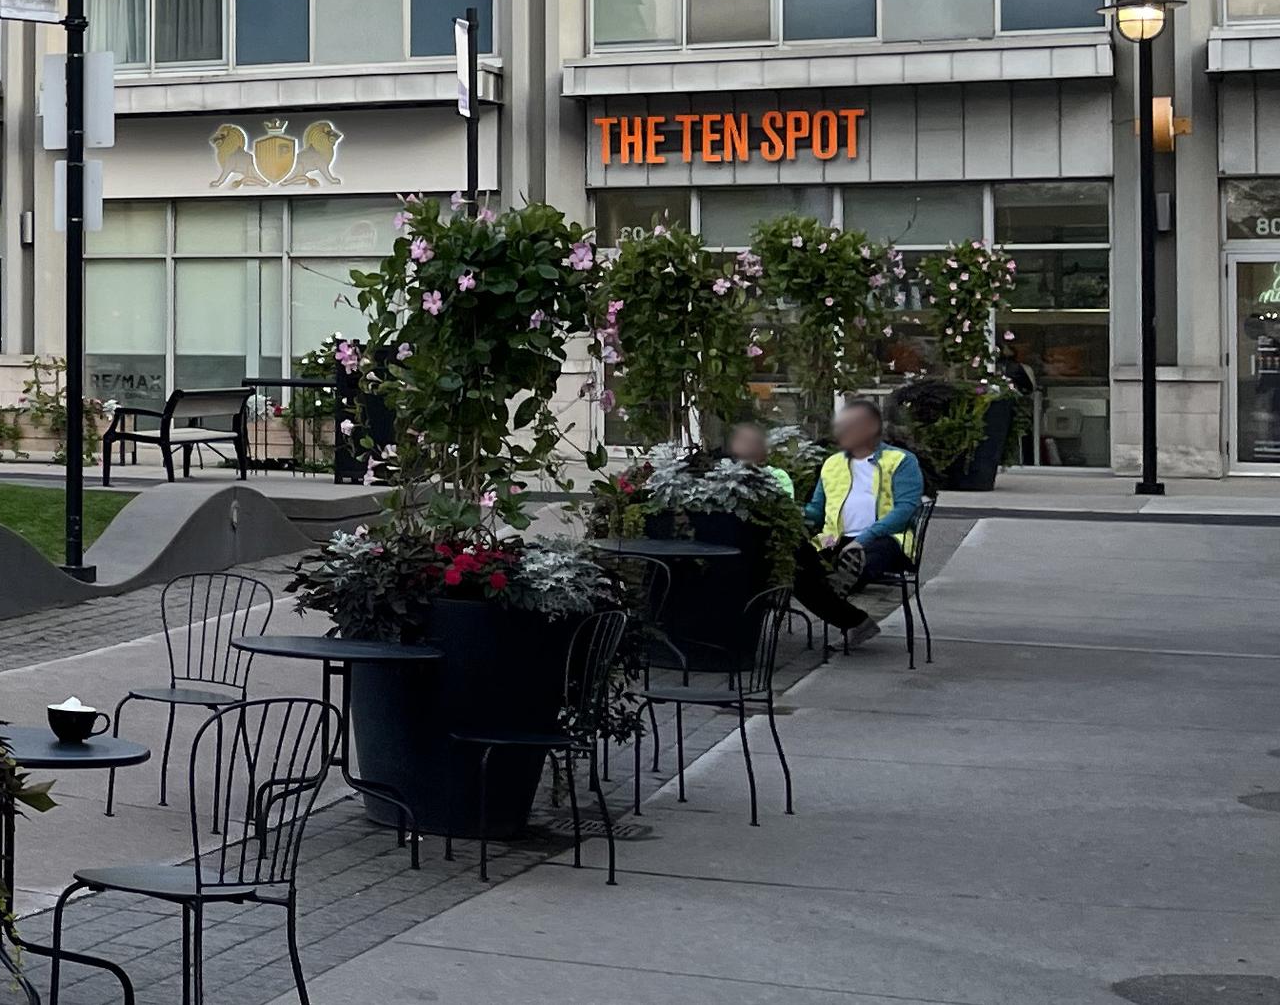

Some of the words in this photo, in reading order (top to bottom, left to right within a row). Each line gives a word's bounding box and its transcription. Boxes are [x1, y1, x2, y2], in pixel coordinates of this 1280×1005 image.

[593, 116, 666, 164] THE
[675, 113, 749, 163] TEN
[760, 109, 865, 162] SPOT
[90, 374, 161, 391] RE/MAX
